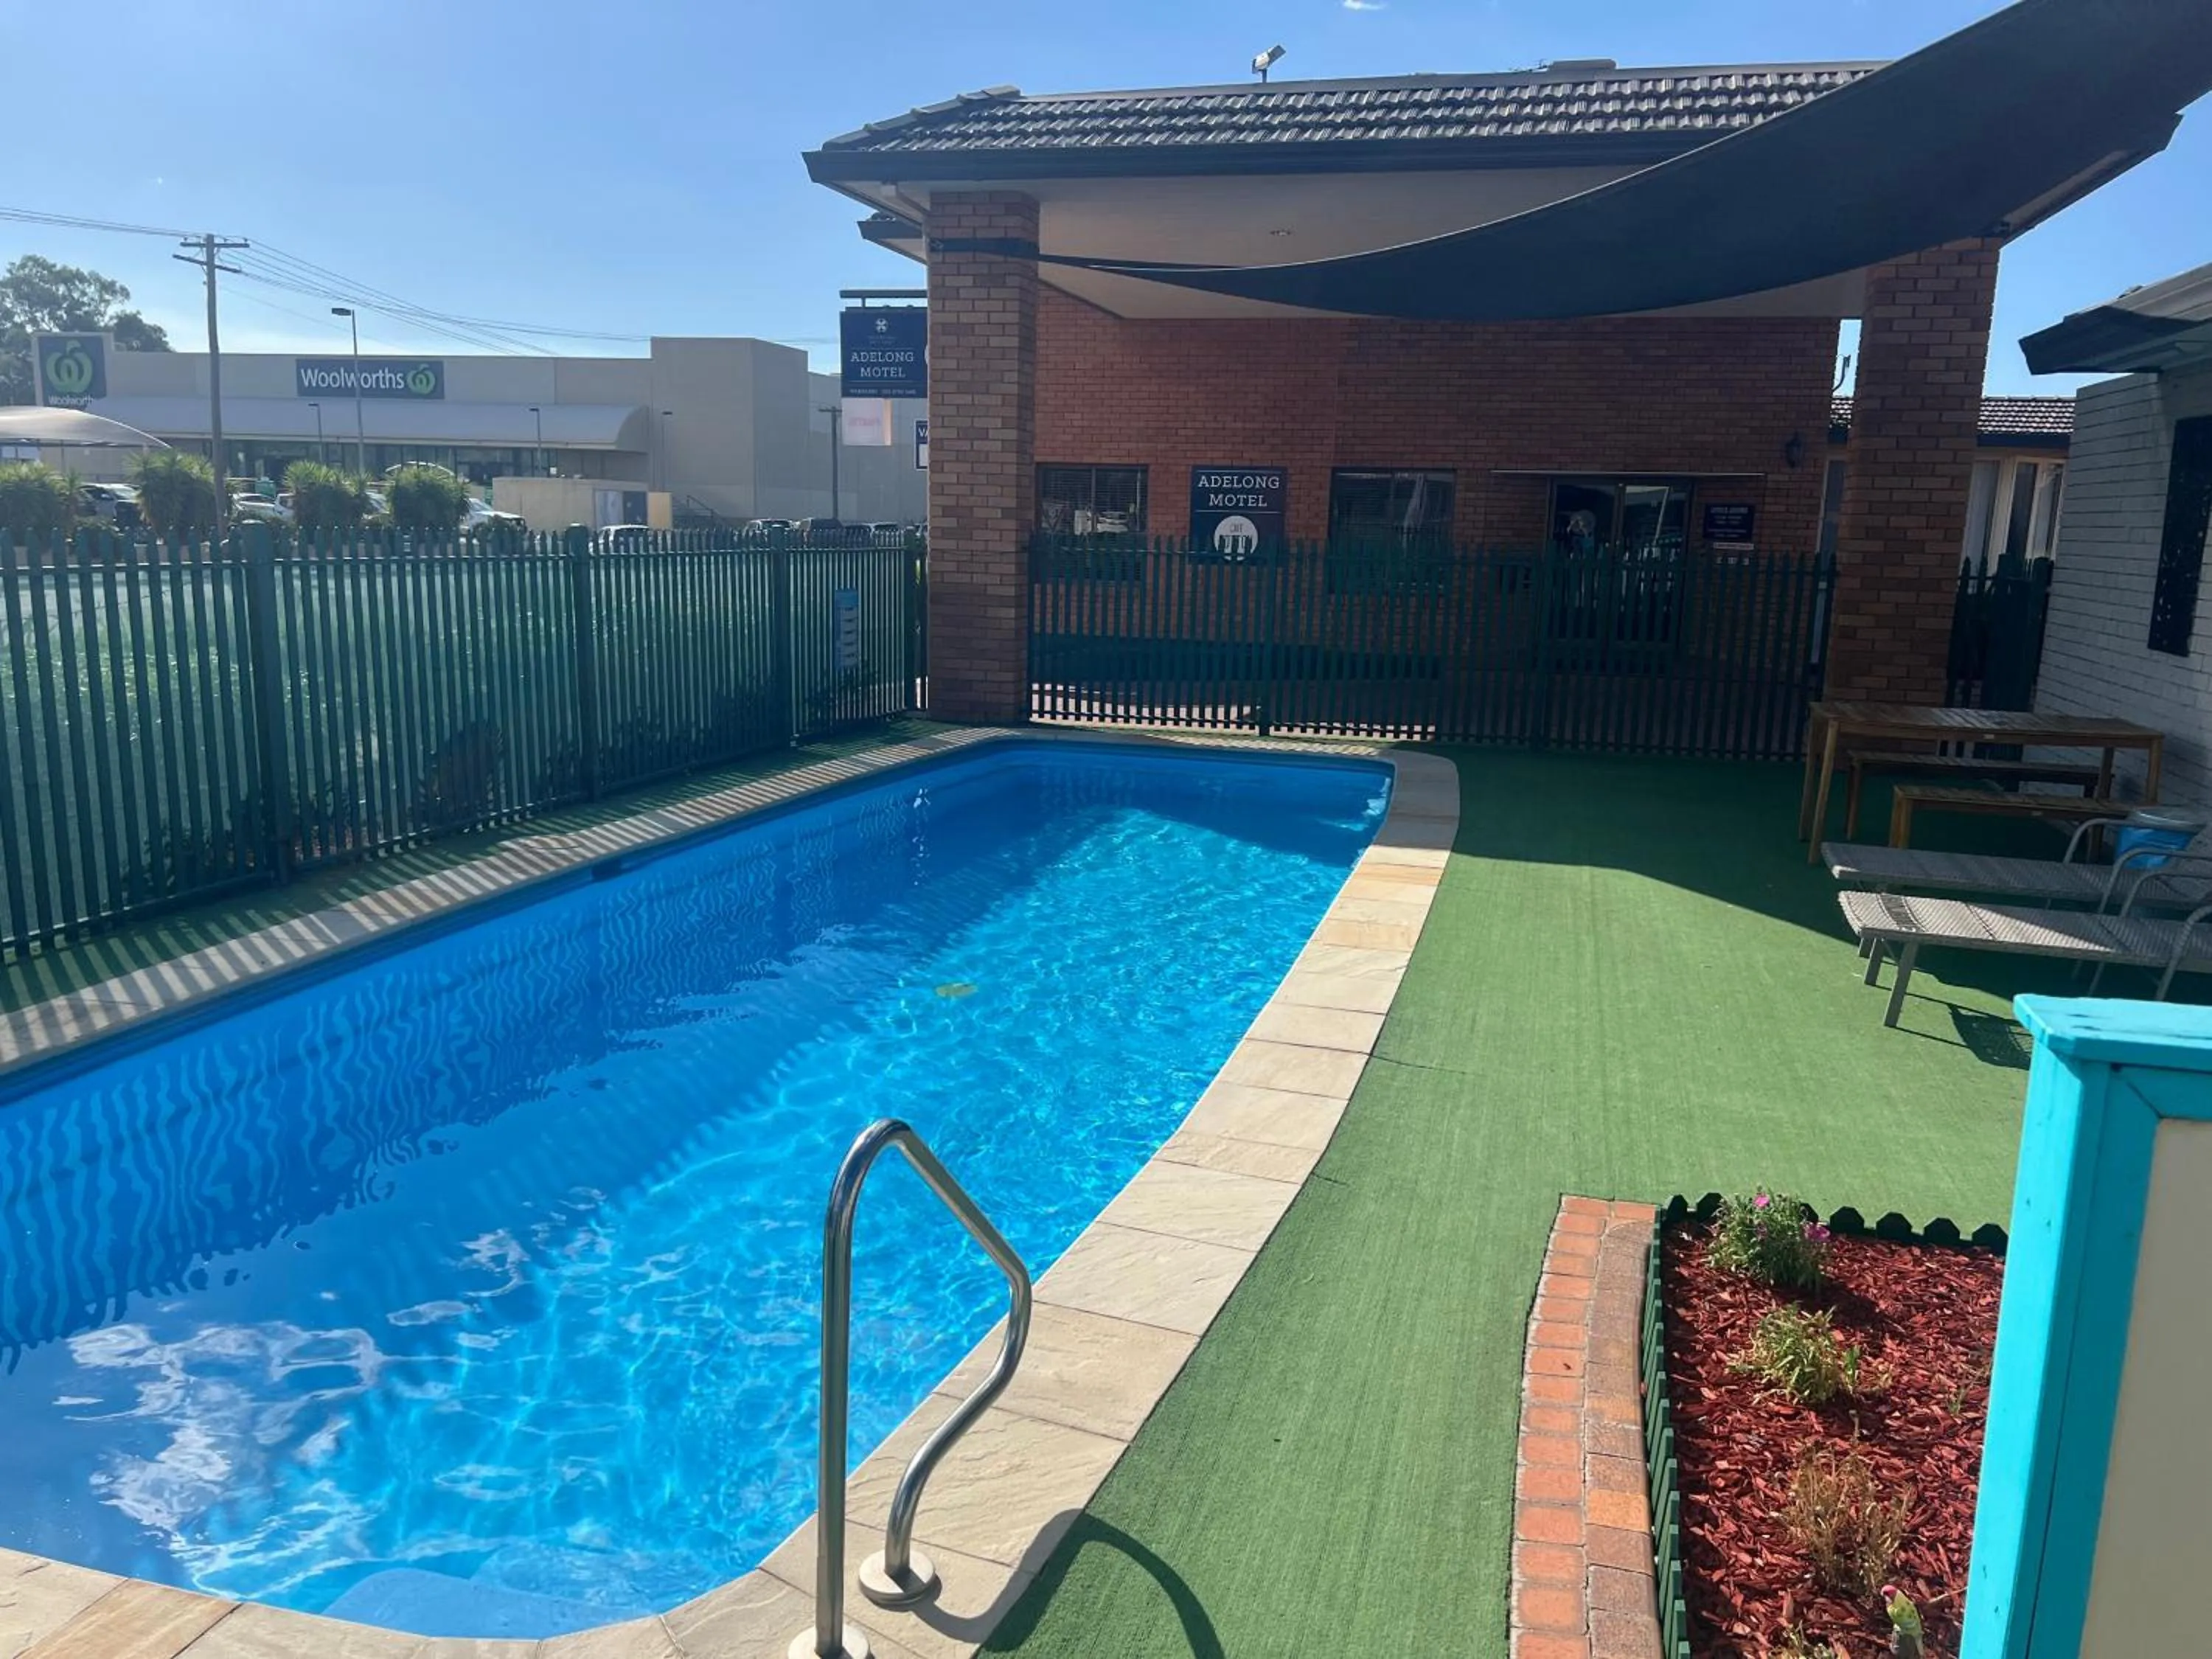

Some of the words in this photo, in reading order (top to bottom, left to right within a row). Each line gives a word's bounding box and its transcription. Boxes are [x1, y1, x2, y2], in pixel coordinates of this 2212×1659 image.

[850, 351, 914, 362] ADELONG
[300, 366, 405, 389] Woolworths
[860, 366, 906, 378] MOTEL
[48, 394, 94, 406] Woolworth
[1197, 475, 1280, 489] ADELONG
[1209, 493, 1267, 507] MOTEL
